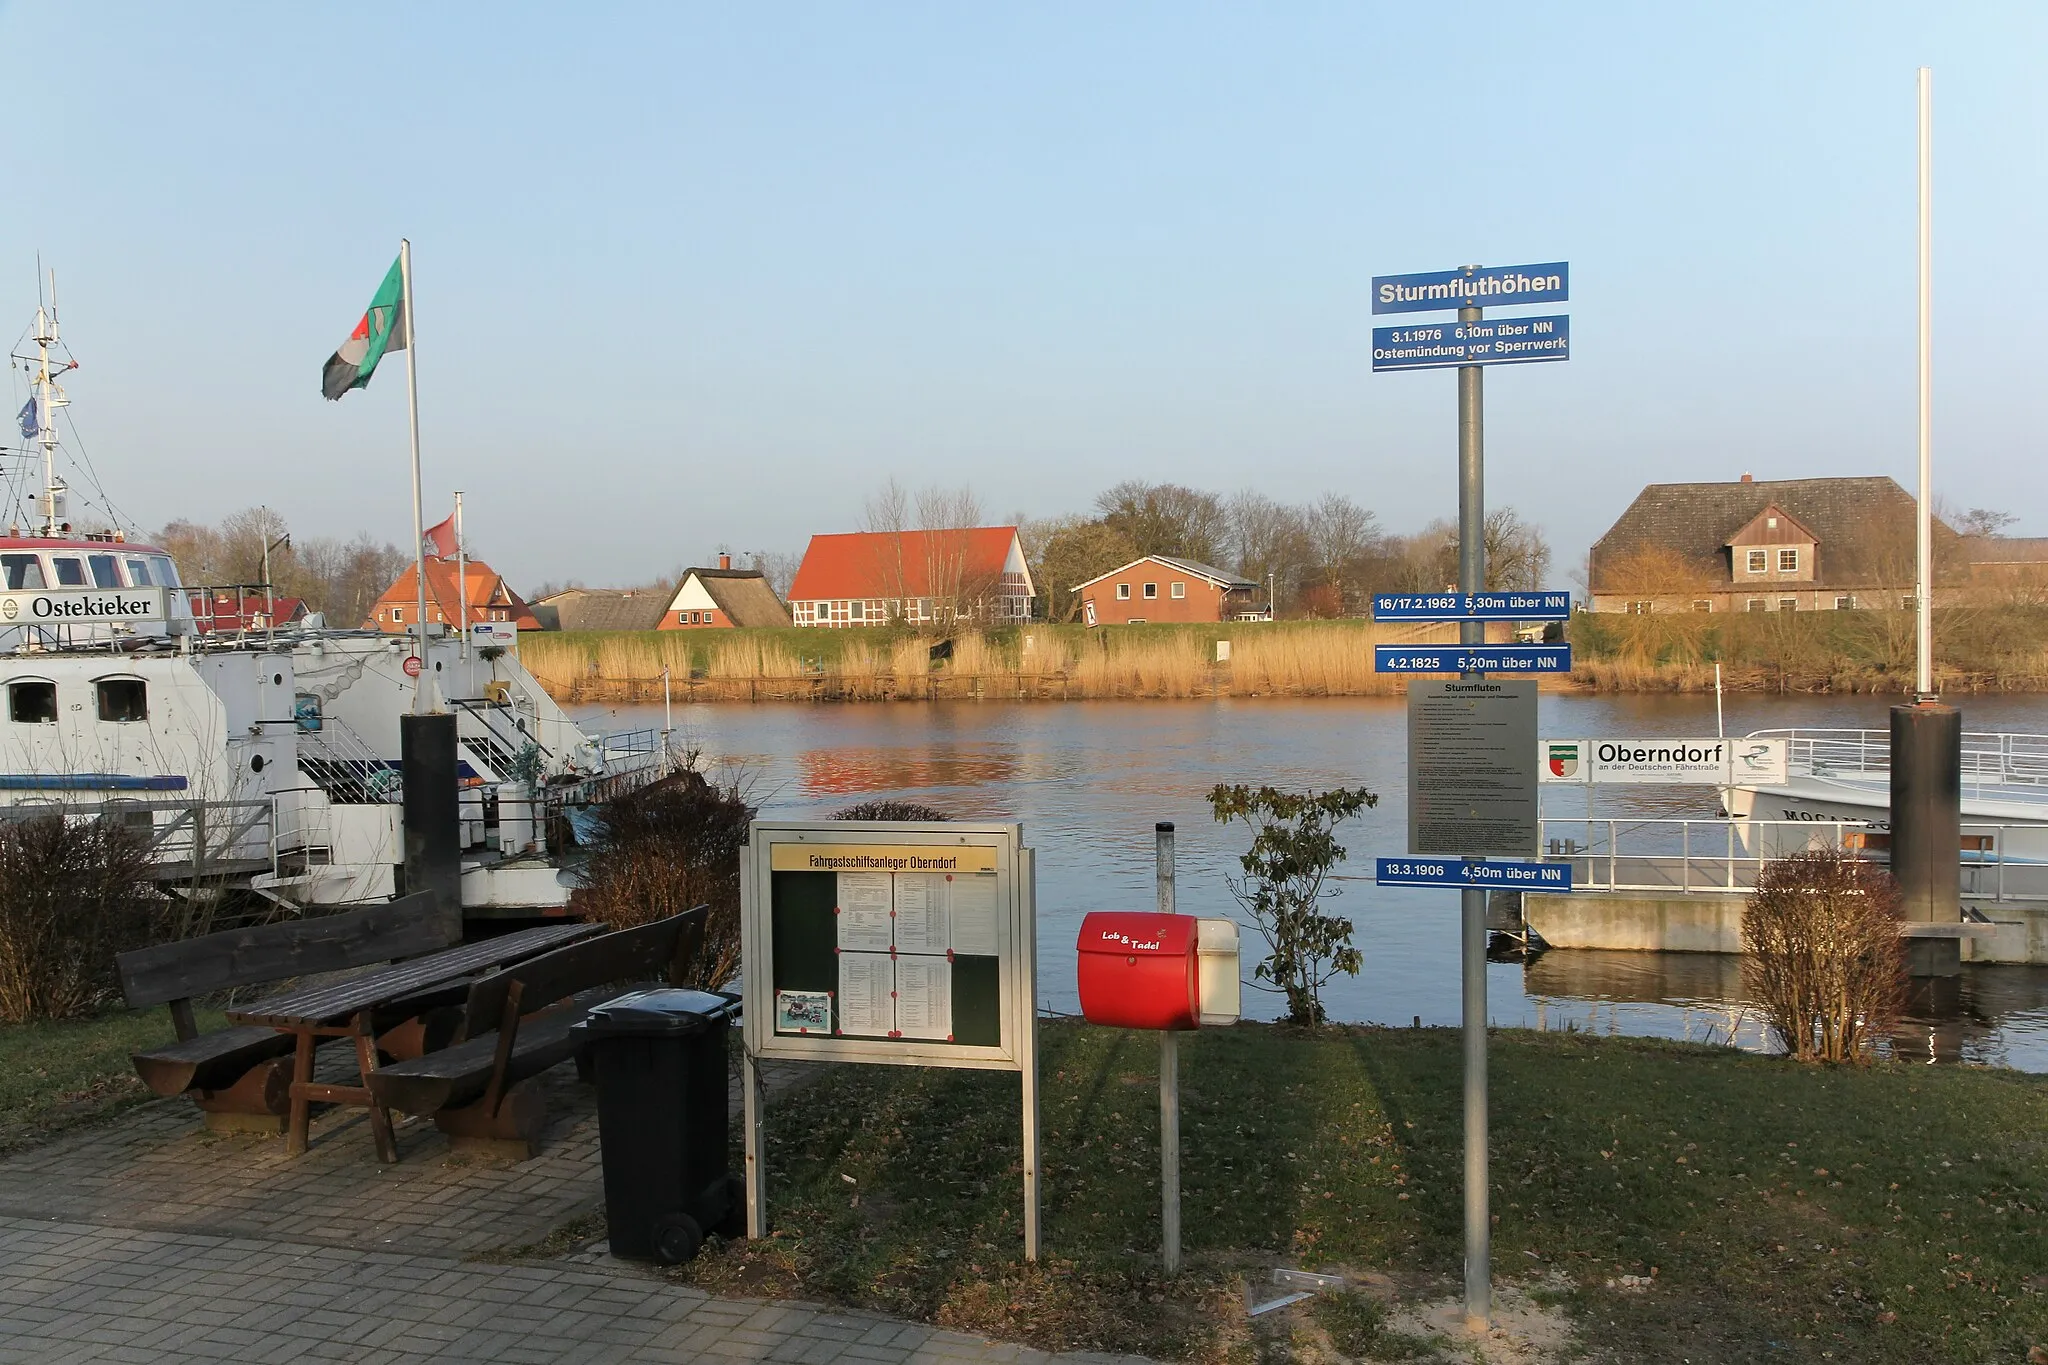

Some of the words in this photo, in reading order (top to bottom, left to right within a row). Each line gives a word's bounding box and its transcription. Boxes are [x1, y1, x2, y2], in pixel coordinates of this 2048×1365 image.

[1379, 274, 1561, 304] Sturmfluthöhen
[1392, 329, 1442, 343] 3.1.1976
[1455, 327, 1494, 341] 6,10m
[1498, 324, 1529, 337] über
[1533, 321, 1553, 334] NN
[1373, 343, 1465, 360] Ostemündung
[1469, 343, 1491, 354] vor
[1495, 337, 1567, 354] Sperrwerk
[32, 595, 151, 617] Ostekieker
[1378, 598, 1456, 610] 16/17.2.1962
[1464, 597, 1506, 611] 5,30m
[1510, 596, 1541, 608] über
[1545, 596, 1565, 608] NN
[1387, 657, 1440, 669] 4.2.1825
[1457, 657, 1498, 671] 5,20m
[1502, 656, 1533, 668] über
[1537, 657, 1557, 668] NN
[1445, 683, 1501, 692] Sturmfluten
[1598, 744, 1722, 762] Oberndorf
[1628, 763, 1673, 771] Deutschen
[1675, 763, 1720, 771] Fährstraße
[809, 855, 908, 870] Fahrgastschiffsanleger
[910, 856, 957, 869] Oberndorf
[1386, 863, 1444, 876] 13.3.1906
[1461, 866, 1502, 880] 4,50m
[1506, 867, 1537, 880] über
[1541, 869, 1561, 881] NN
[1102, 931, 1120, 940] Lob
[1120, 935, 1129, 945] &
[1131, 940, 1160, 951] Tadel
